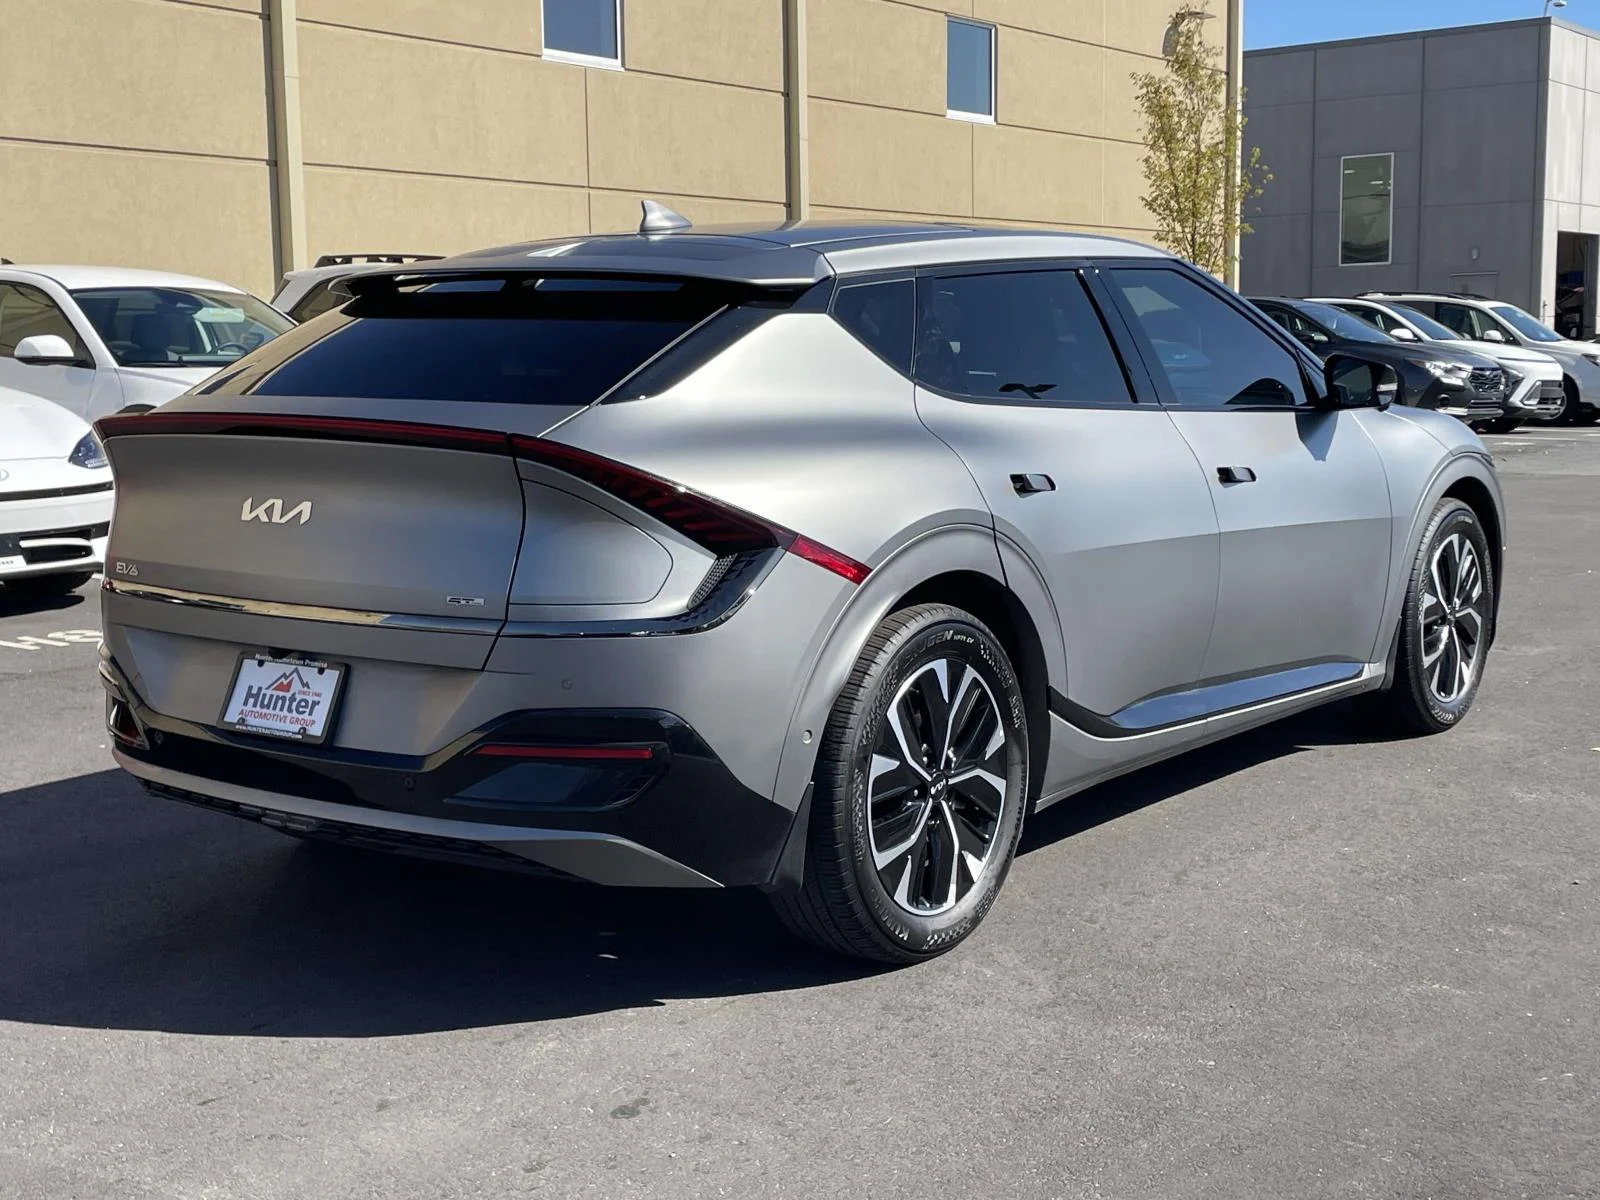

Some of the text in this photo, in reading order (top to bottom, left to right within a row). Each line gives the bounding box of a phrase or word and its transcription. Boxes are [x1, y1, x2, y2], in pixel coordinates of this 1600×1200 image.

[116, 562, 139, 576] EV6
[242, 685, 321, 717] Hunter
[239, 709, 316, 728] AUTOMOTIVE GROUP
